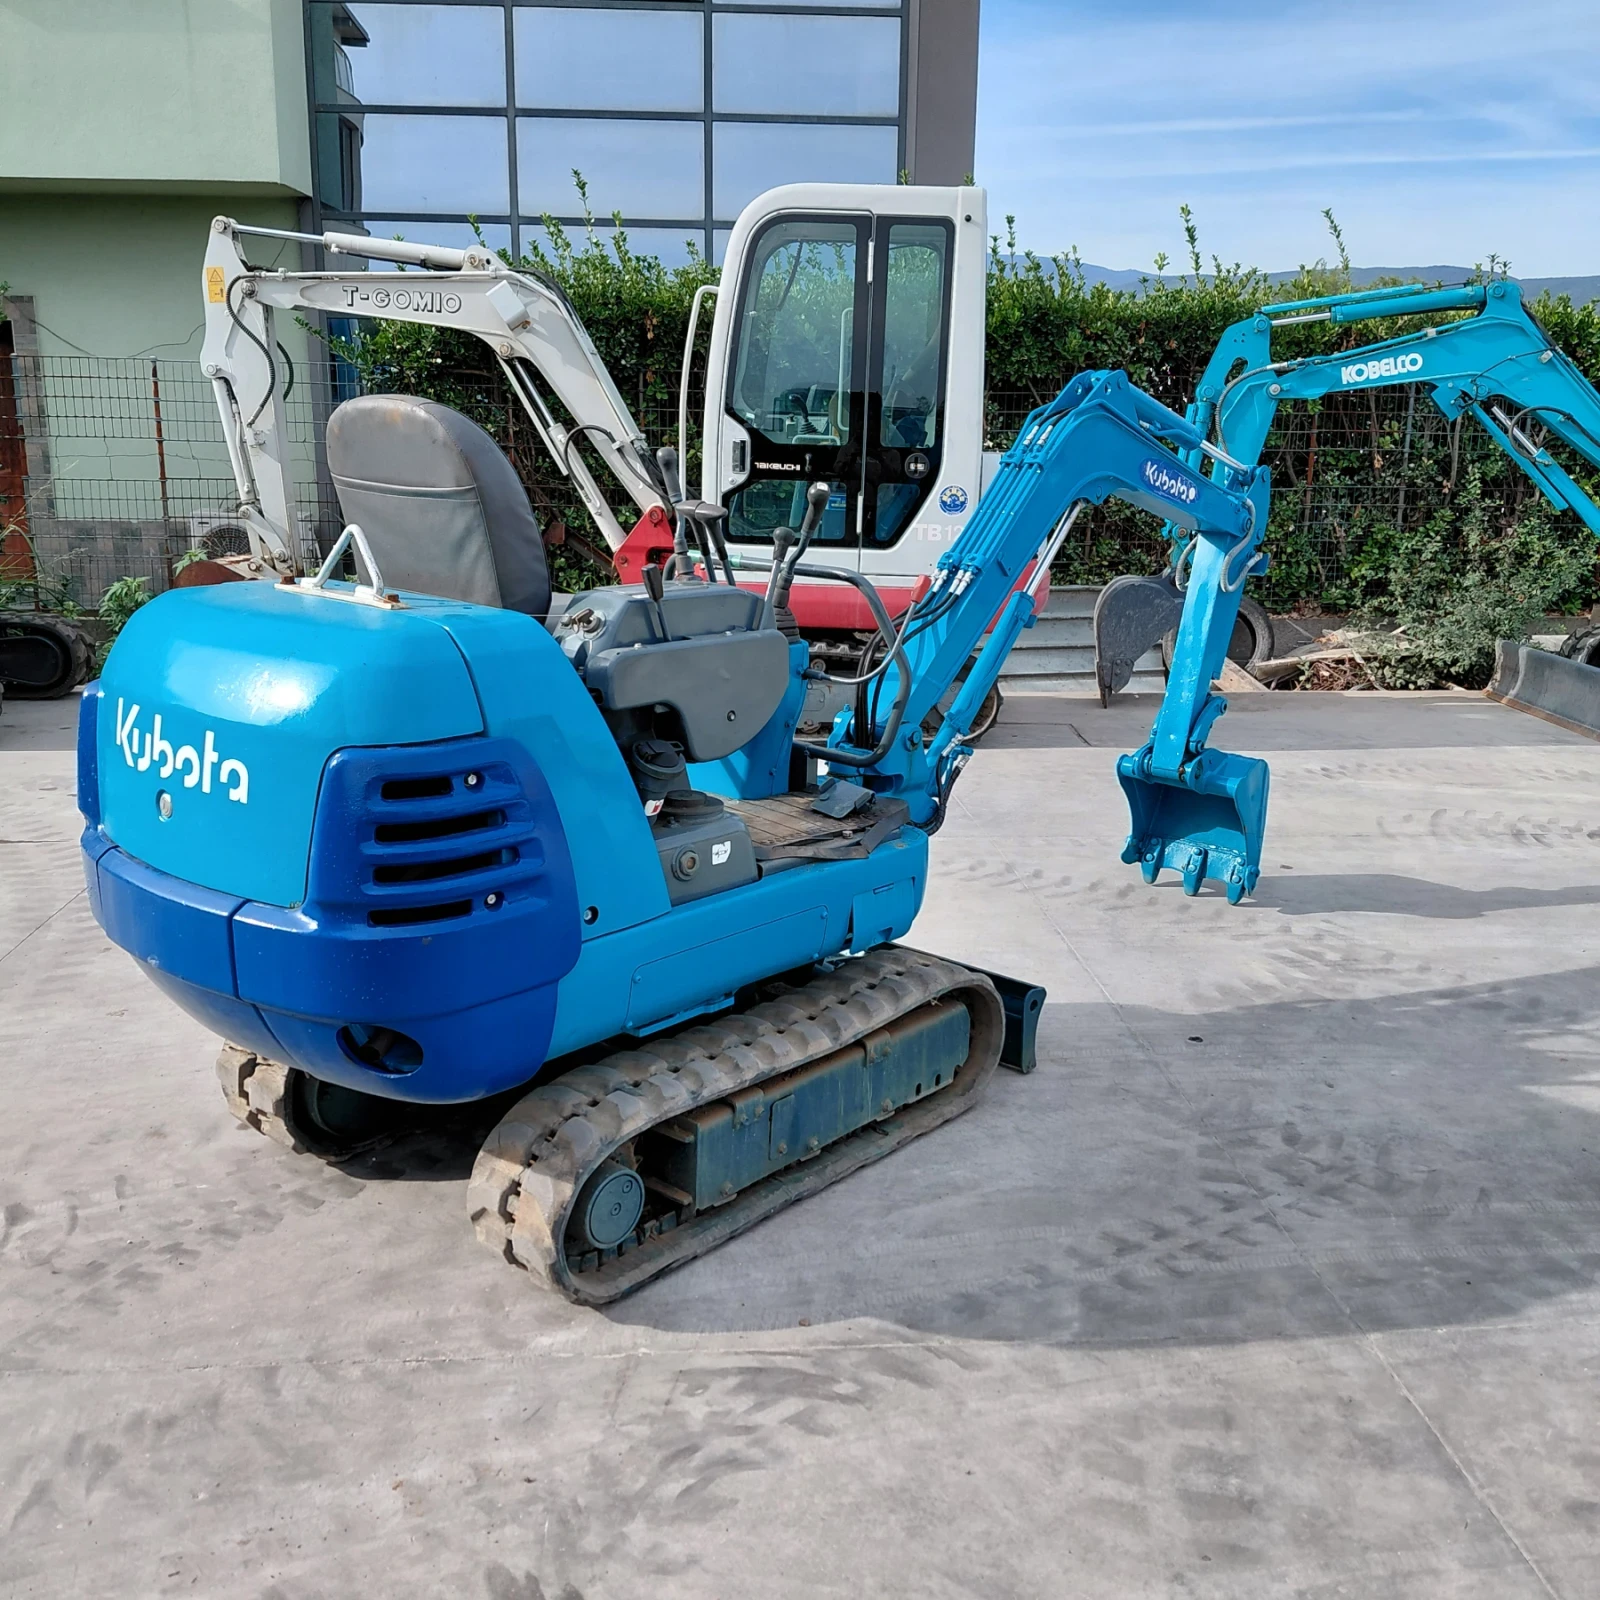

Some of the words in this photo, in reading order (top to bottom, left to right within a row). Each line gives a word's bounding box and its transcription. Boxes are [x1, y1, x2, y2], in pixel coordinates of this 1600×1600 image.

[342, 285, 462, 314] T-GOMIO
[1341, 353, 1423, 385] KOBELCO
[1145, 461, 1187, 500] Kubota
[116, 697, 249, 804] Kubota
